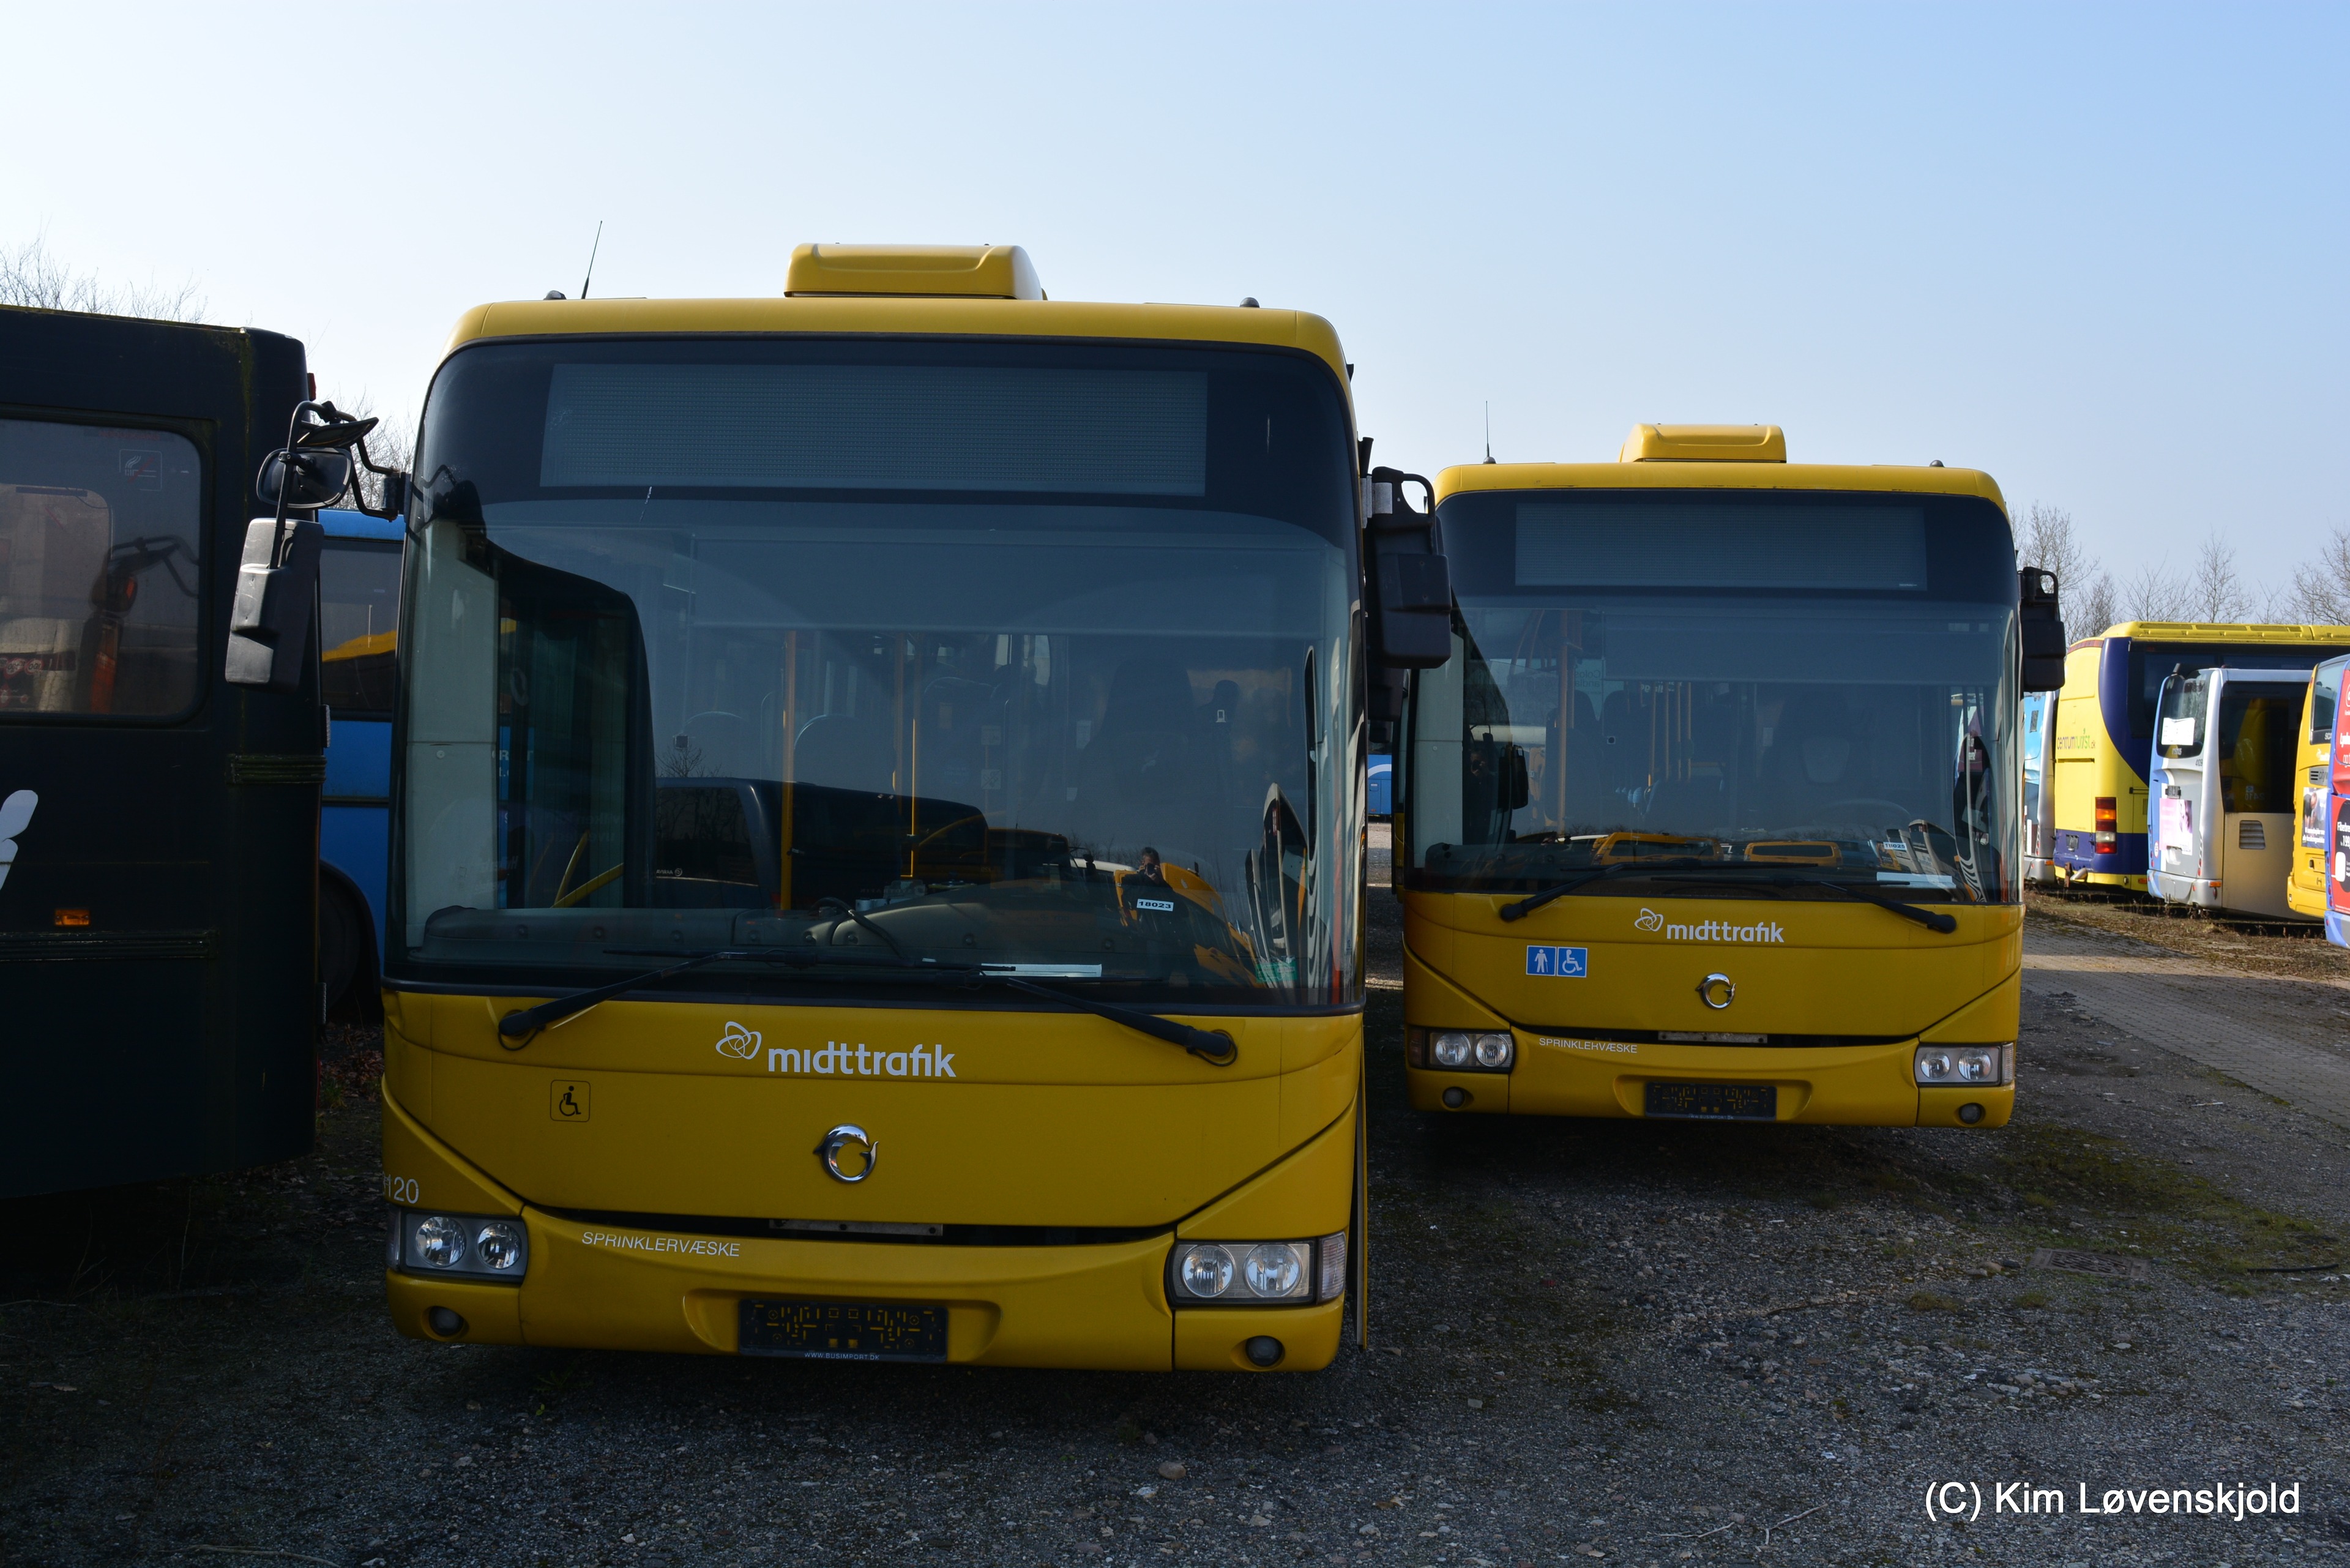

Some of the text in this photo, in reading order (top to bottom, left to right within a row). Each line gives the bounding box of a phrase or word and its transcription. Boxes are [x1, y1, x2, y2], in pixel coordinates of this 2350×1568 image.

[1666, 920, 1785, 943] midttrafik
[768, 1041, 957, 1077] midttrafik
[581, 1231, 740, 1257] SPRINKLERVÆSKE
[804, 1352, 880, 1361] WWW.BUSIMPORT.DK
